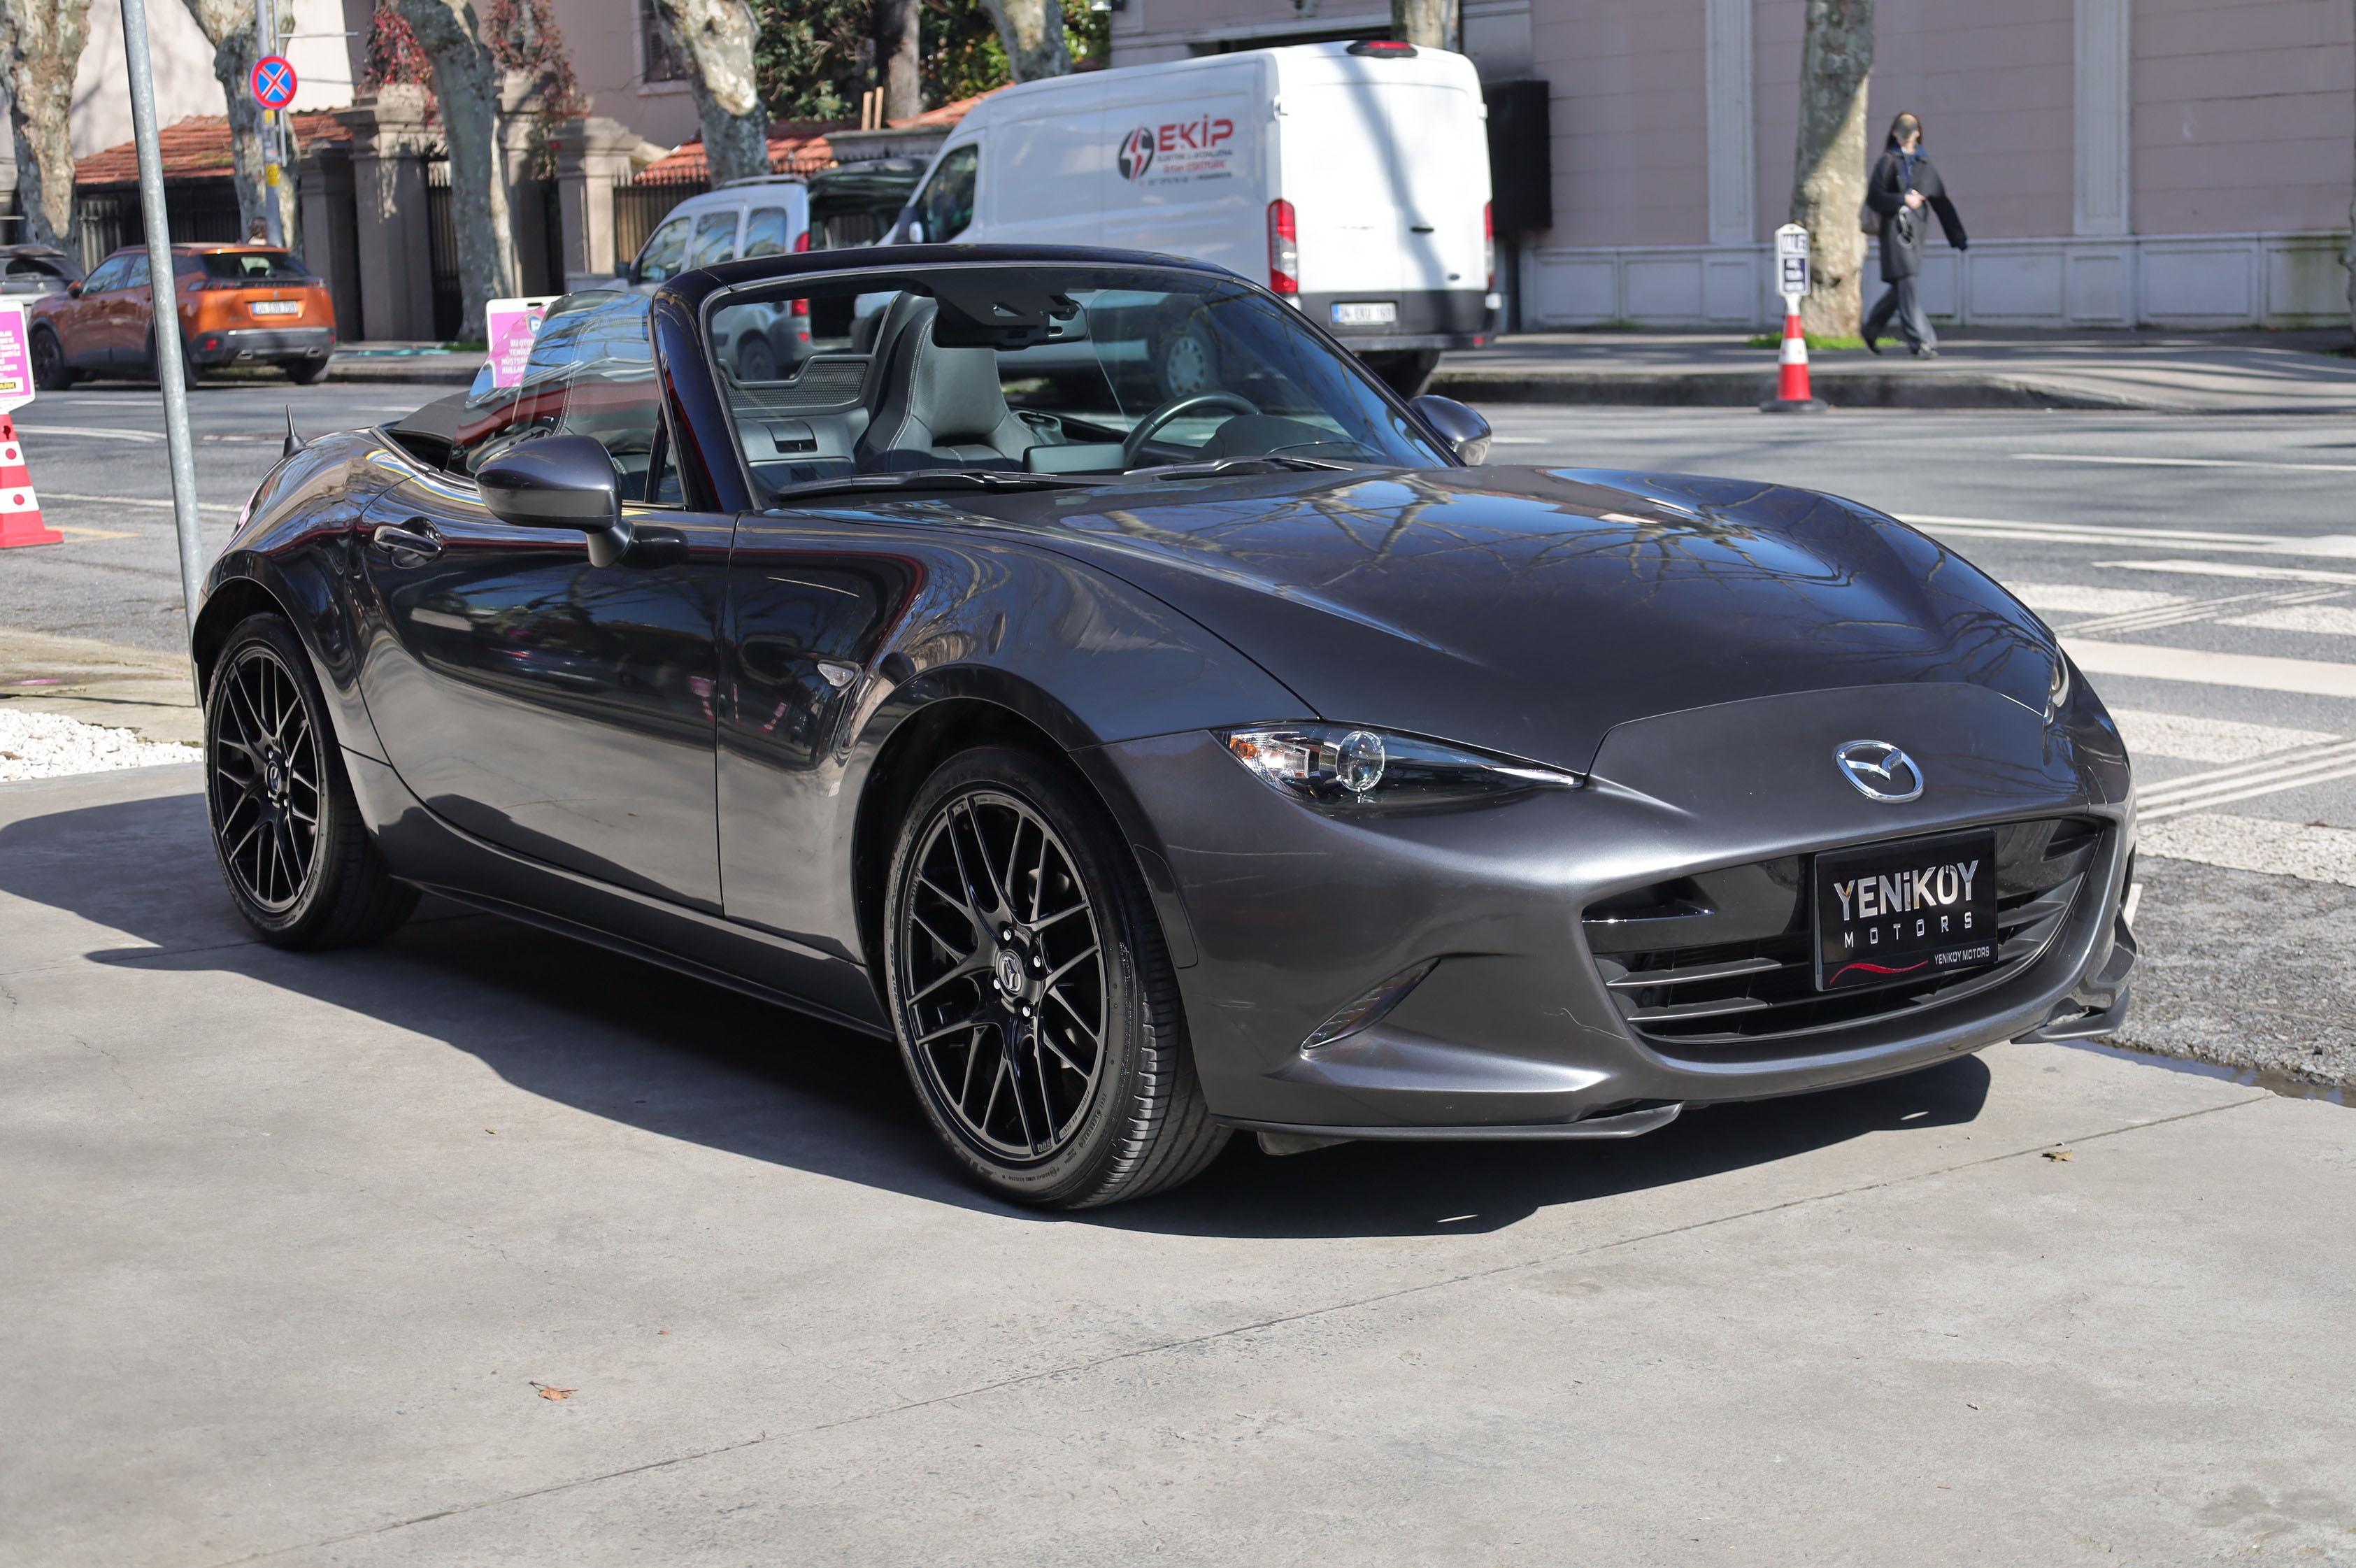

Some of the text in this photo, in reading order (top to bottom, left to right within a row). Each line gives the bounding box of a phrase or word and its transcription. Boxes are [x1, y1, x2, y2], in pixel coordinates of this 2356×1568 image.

[1159, 113, 1234, 151] EKİP
[1844, 911, 1972, 948] MOTORS
[1962, 946, 1990, 962] MOTORS
